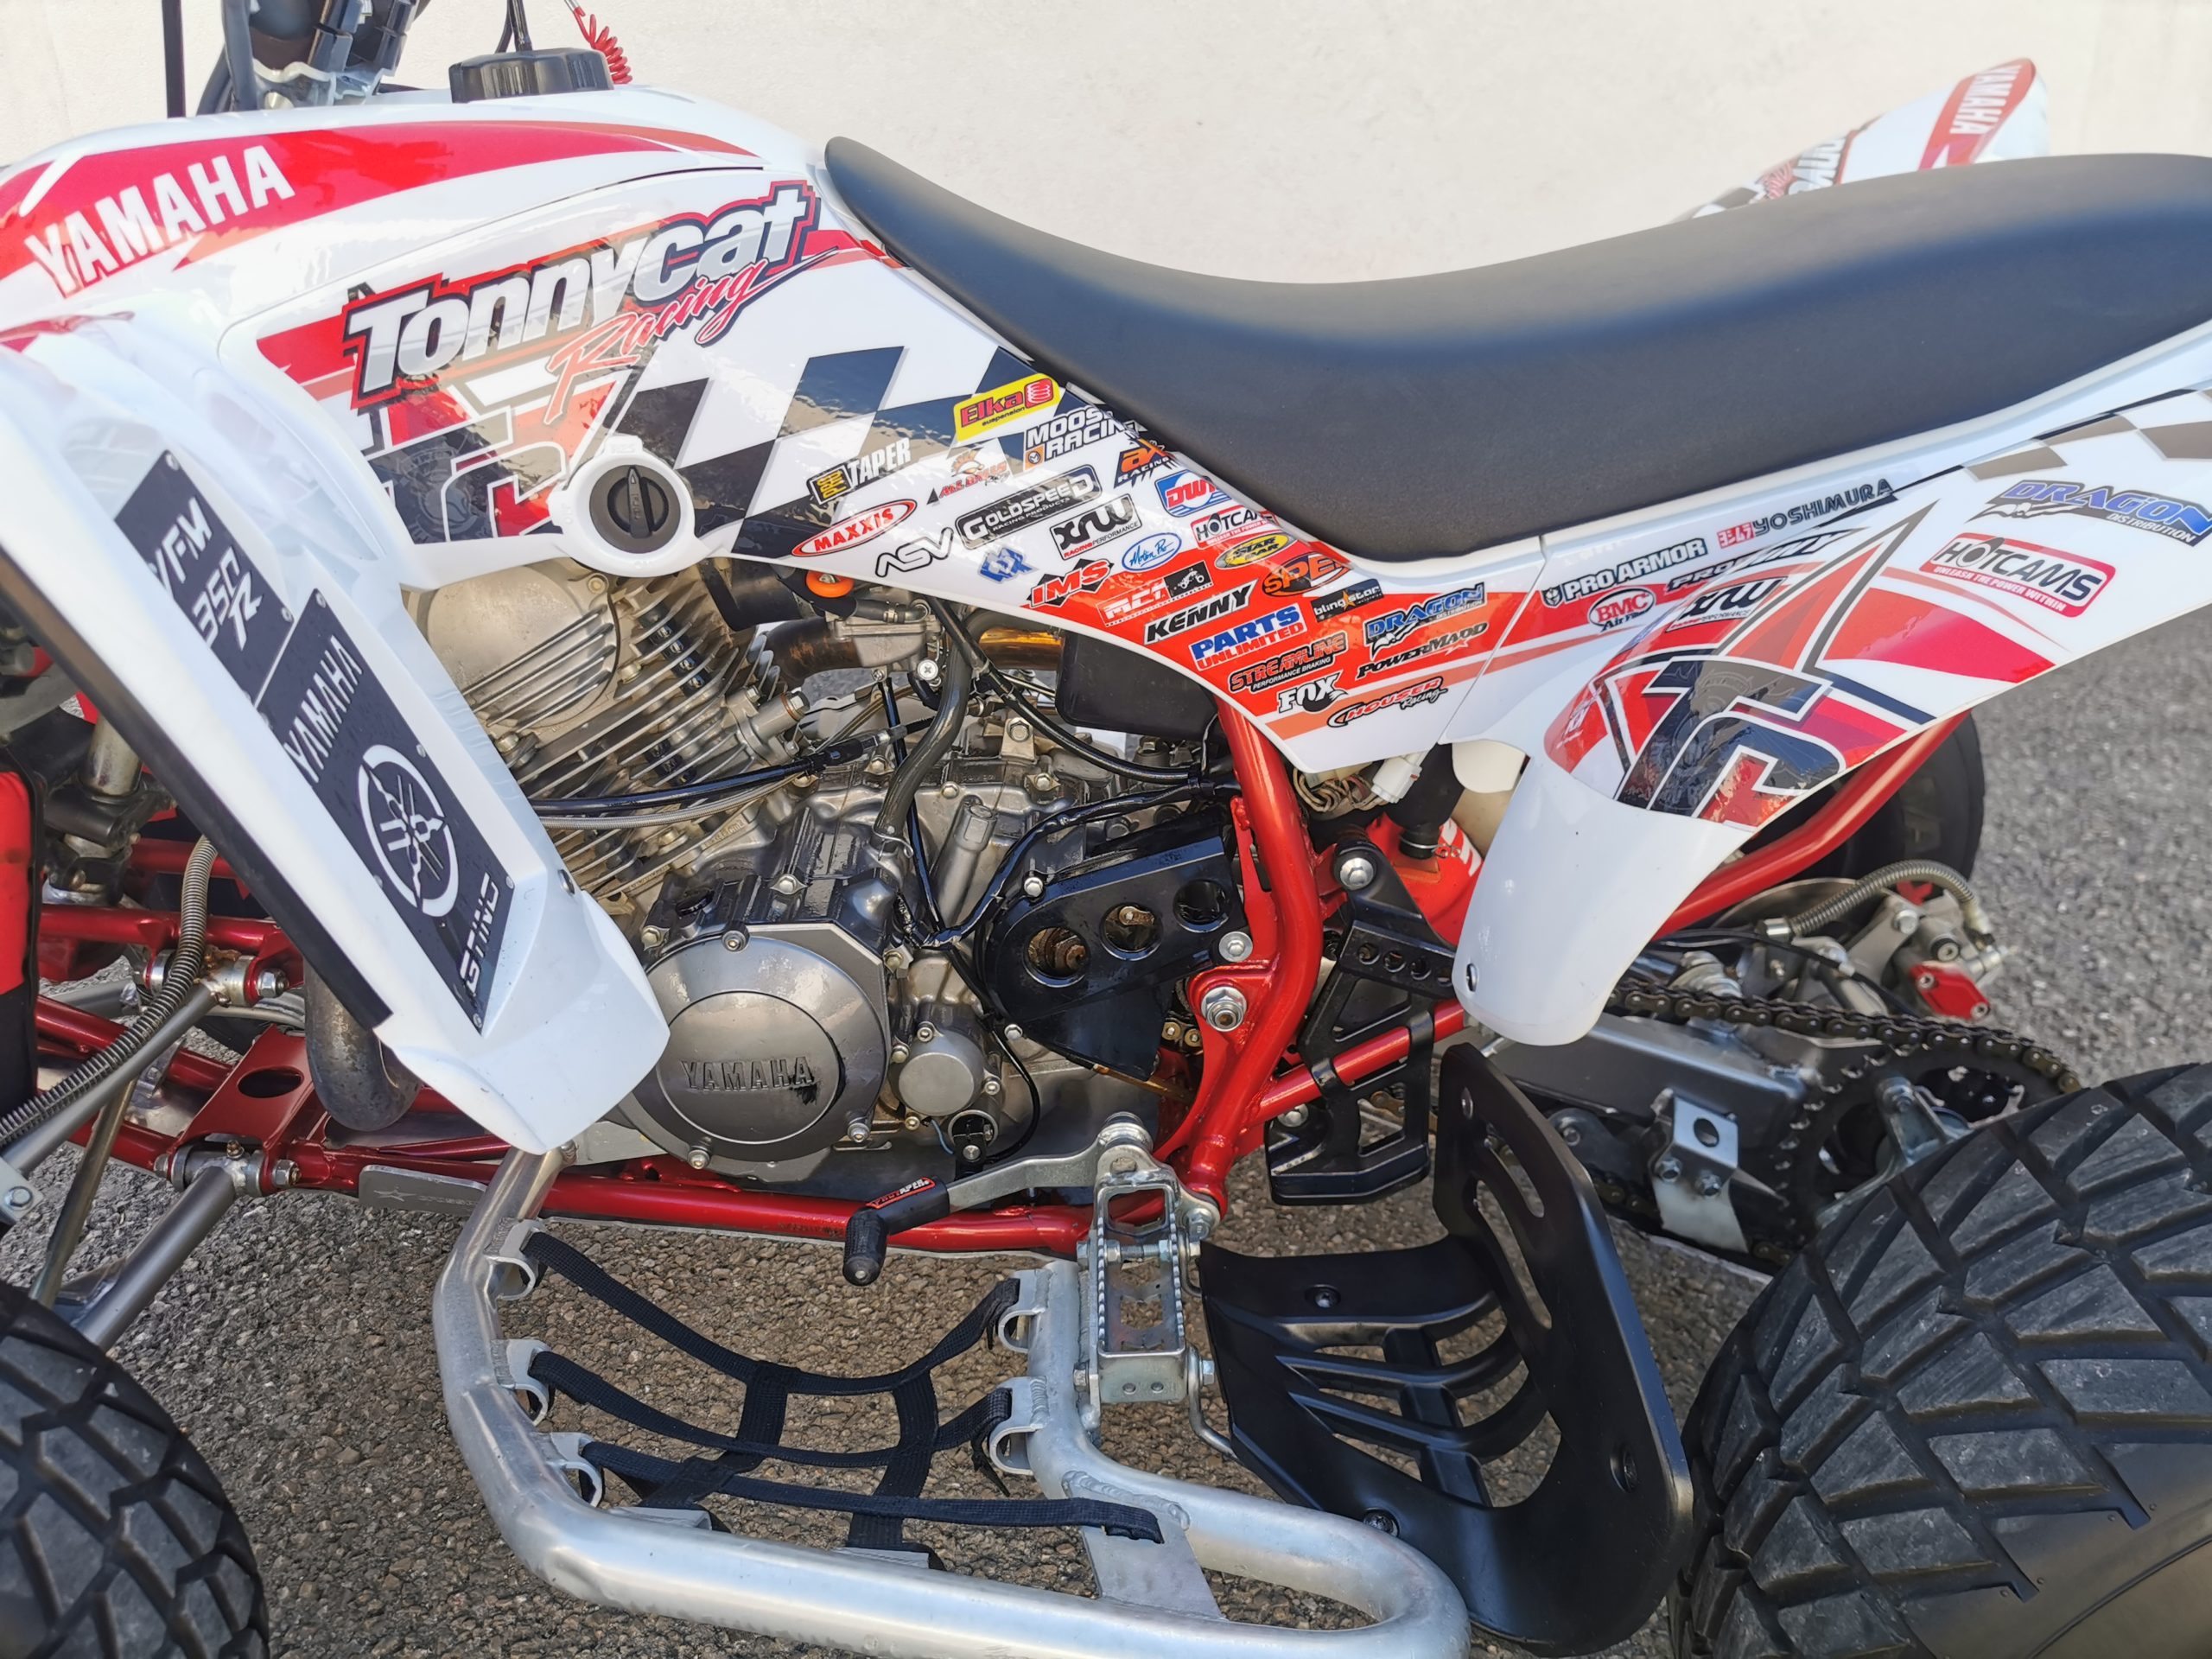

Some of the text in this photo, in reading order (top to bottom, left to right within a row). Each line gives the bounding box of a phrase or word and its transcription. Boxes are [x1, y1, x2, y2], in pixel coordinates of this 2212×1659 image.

[1949, 65, 2021, 135] YAMAHA
[24, 144, 296, 299] YAMAHA
[346, 185, 809, 396] Tonnycat
[543, 245, 840, 425] Racing
[960, 391, 1023, 428] Elka
[847, 437, 912, 489] TAPER
[814, 507, 895, 553] MAXXIS
[963, 474, 1095, 540] GOLDSPEED
[1752, 479, 1894, 537] YOSHIMURA
[2002, 480, 2212, 535] DRAGON
[2106, 512, 2196, 543] DISTRIBUTION
[1031, 561, 1109, 606] IMS
[1564, 538, 1707, 601] PRO ARMOR
[1932, 537, 2103, 601] HOTCAMS
[1932, 566, 2068, 612] UNLEASH THE POWER WITHIN
[1147, 585, 1252, 643] KENNY
[1313, 598, 1347, 616] bling
[1348, 586, 1381, 602] star
[1367, 584, 1484, 638] DRAGON
[1596, 593, 1649, 622] BMC
[1191, 606, 1300, 661] PARTS
[1198, 623, 1305, 669] UNLIMITED
[1231, 633, 1345, 690] STREAMLINE
[1253, 655, 1332, 690] PERFORMANCE BRAKING
[283, 635, 363, 784] YAMAHA
[1279, 671, 1342, 712] FOX
[1345, 677, 1441, 720] HOUSER
[679, 1056, 814, 1092] YAMAHA
